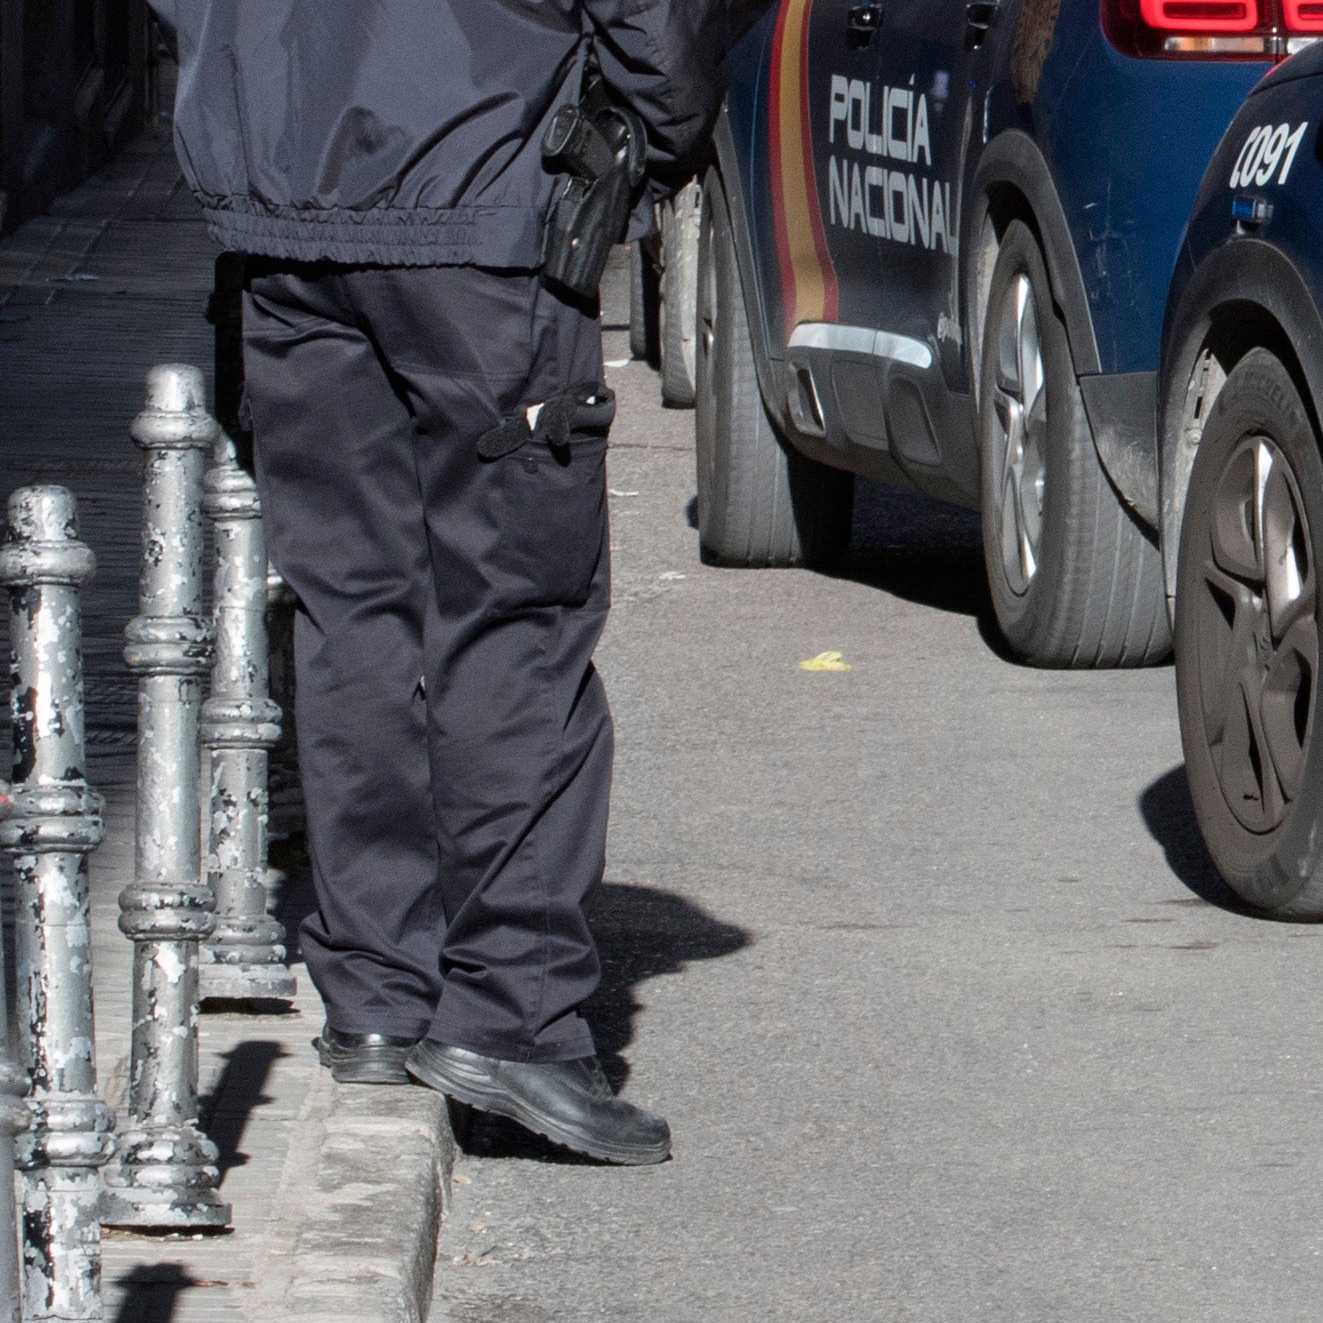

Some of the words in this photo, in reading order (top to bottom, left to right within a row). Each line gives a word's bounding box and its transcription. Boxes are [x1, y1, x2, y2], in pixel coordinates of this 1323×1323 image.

[829, 73, 931, 166] POLICÍA
[1240, 121, 1308, 188] 091
[829, 155, 958, 256] NACIONAL
